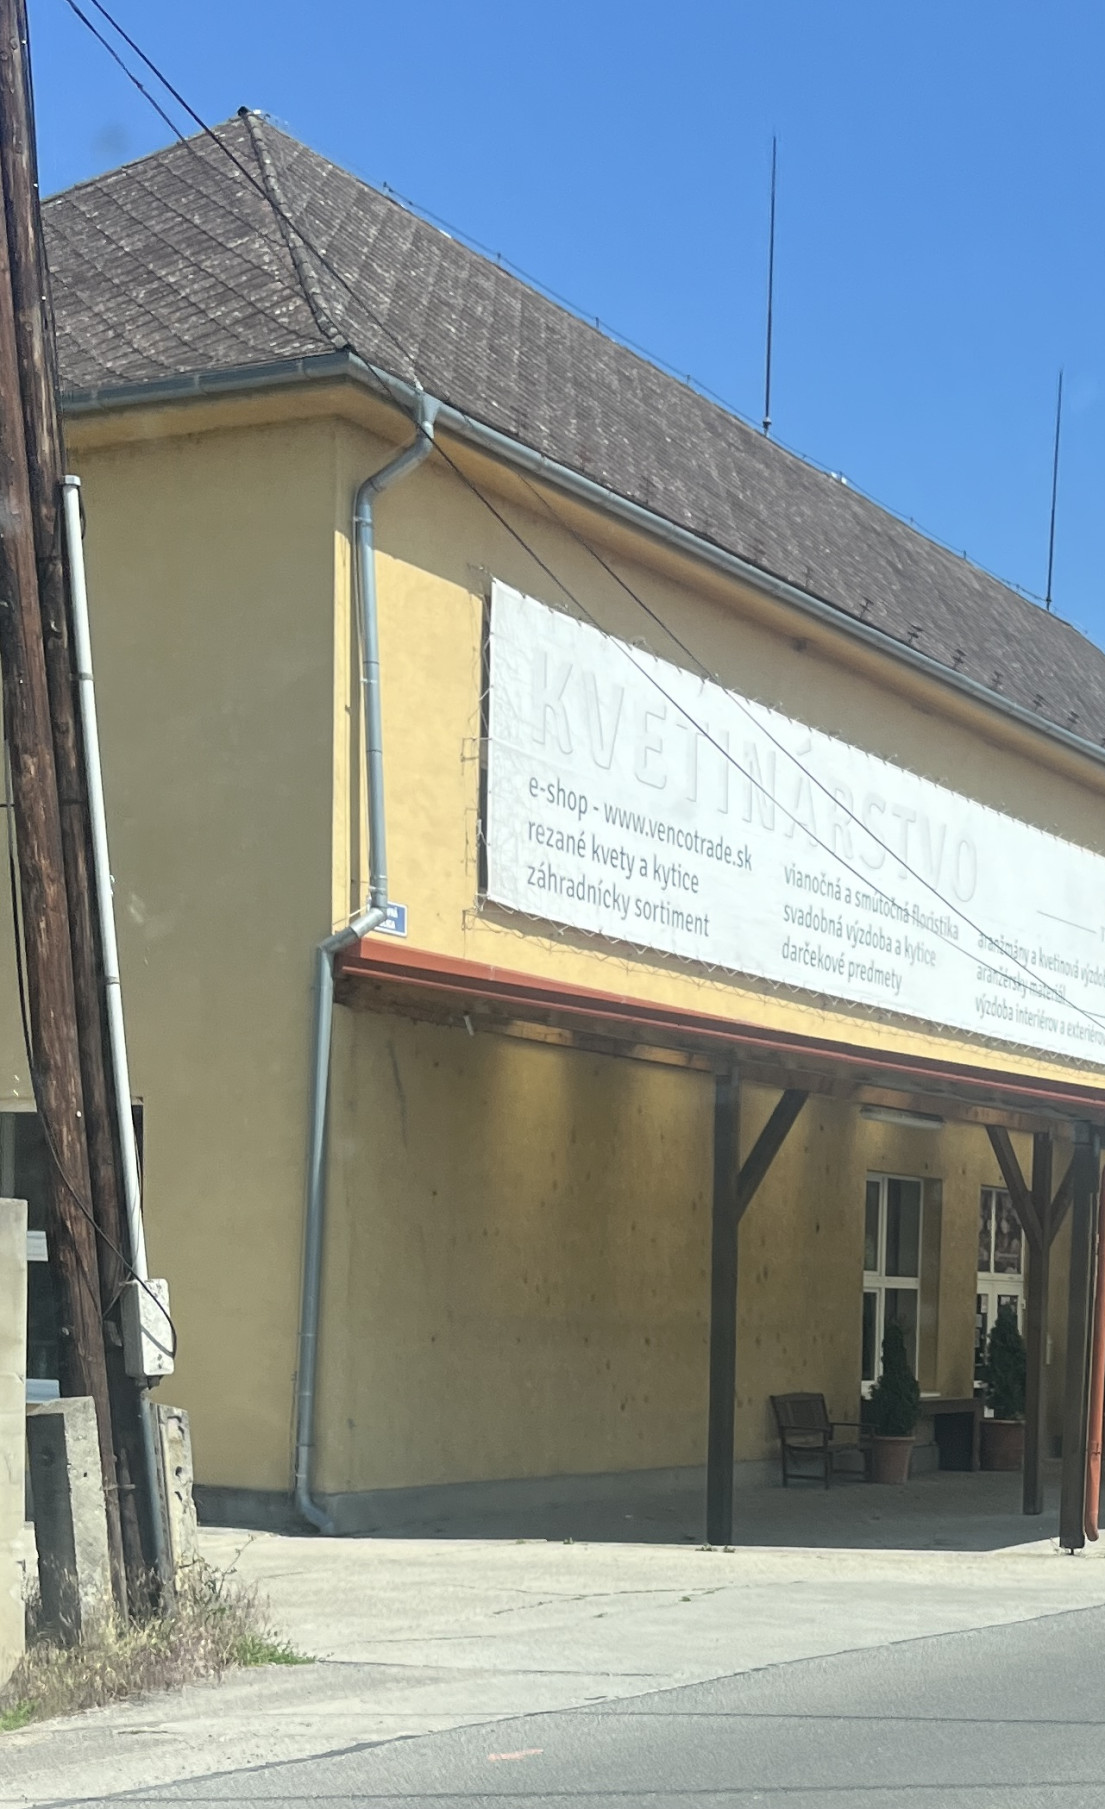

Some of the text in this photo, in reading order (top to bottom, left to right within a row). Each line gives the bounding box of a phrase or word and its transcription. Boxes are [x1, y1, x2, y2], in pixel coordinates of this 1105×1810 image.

[532, 649, 979, 903] KVETINÁRSTVO
[528, 820, 699, 894] rezané kvety a kytice
[529, 776, 588, 821] e-shop
[604, 803, 753, 871] www.vencotrade.sk
[527, 861, 710, 937] záhradnícky sortiment
[783, 903, 936, 967] svadobná výzdoba a kytice
[784, 863, 959, 940] vianočná a smútočná floristika
[781, 935, 902, 996] darčekové predmety
[1031, 950, 1037, 966] a
[1039, 947, 1079, 979] kvetinová
[976, 993, 1013, 1020] výzdoba
[1016, 1003, 1058, 1034] interiérov
[1060, 1020, 1065, 1035] a
